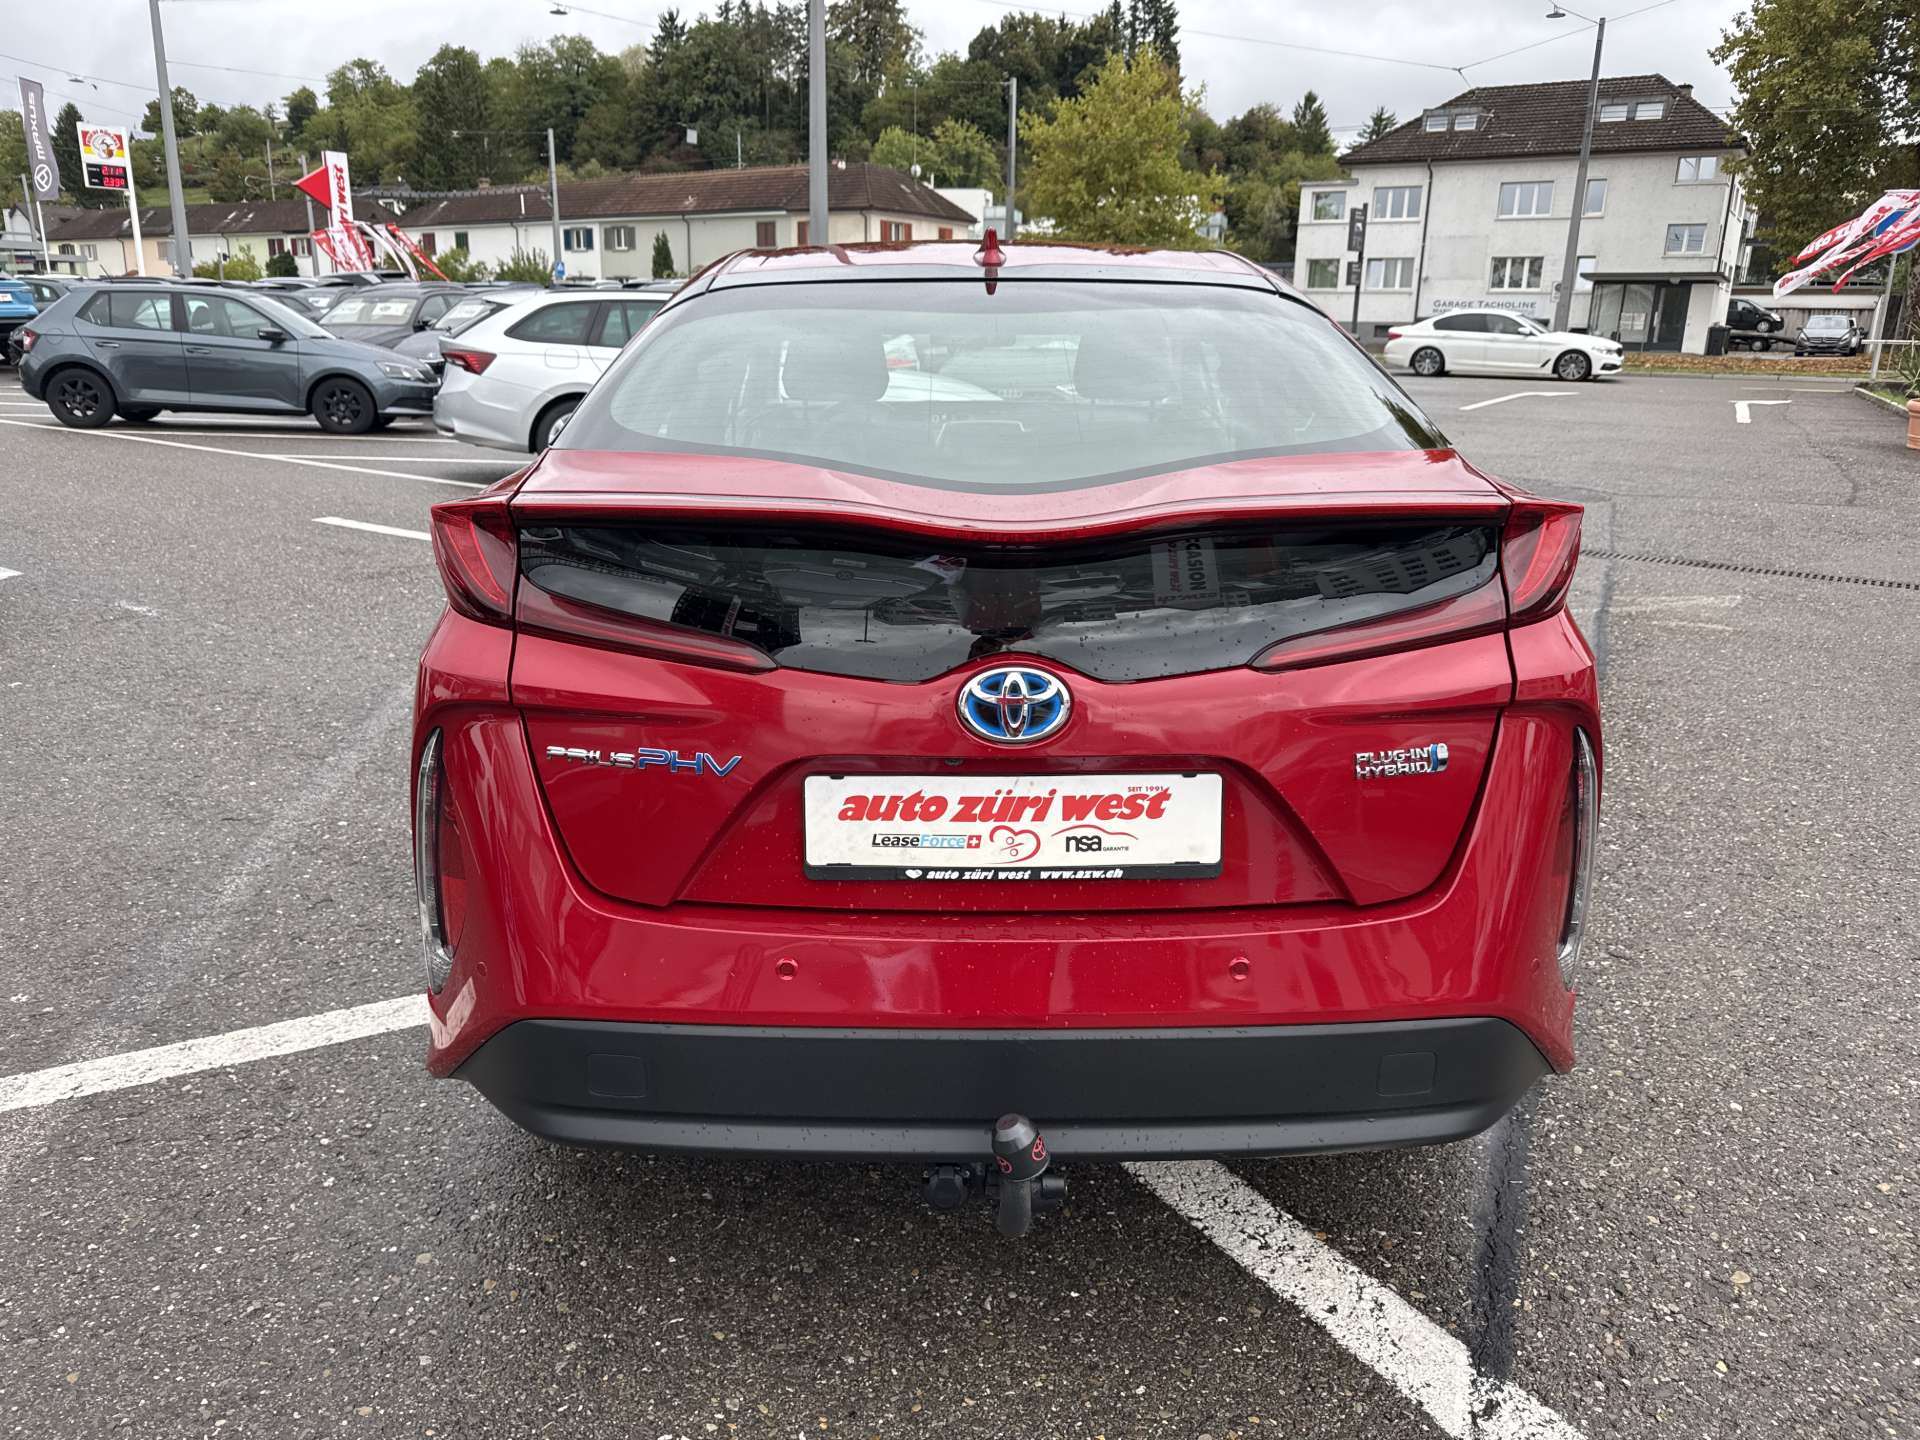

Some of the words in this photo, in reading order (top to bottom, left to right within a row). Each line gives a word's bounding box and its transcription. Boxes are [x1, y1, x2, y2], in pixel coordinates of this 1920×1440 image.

[28, 91, 46, 160] MAXUS
[335, 164, 347, 205] west
[1433, 300, 1472, 308] GARAGE
[1477, 300, 1537, 309] TACHOLINE
[638, 747, 742, 777] PHV
[1355, 746, 1430, 764] PLUG-IN
[1355, 761, 1430, 779] HYBRID
[838, 789, 948, 822] auto
[949, 789, 1057, 822] züri
[1062, 787, 1172, 822] west
[872, 833, 966, 848] LeaseForce
[1066, 835, 1101, 852] nsa
[926, 870, 960, 880] auto
[962, 869, 995, 880] züri
[998, 869, 1031, 880] west
[1040, 868, 1124, 879] www.azw.ch
